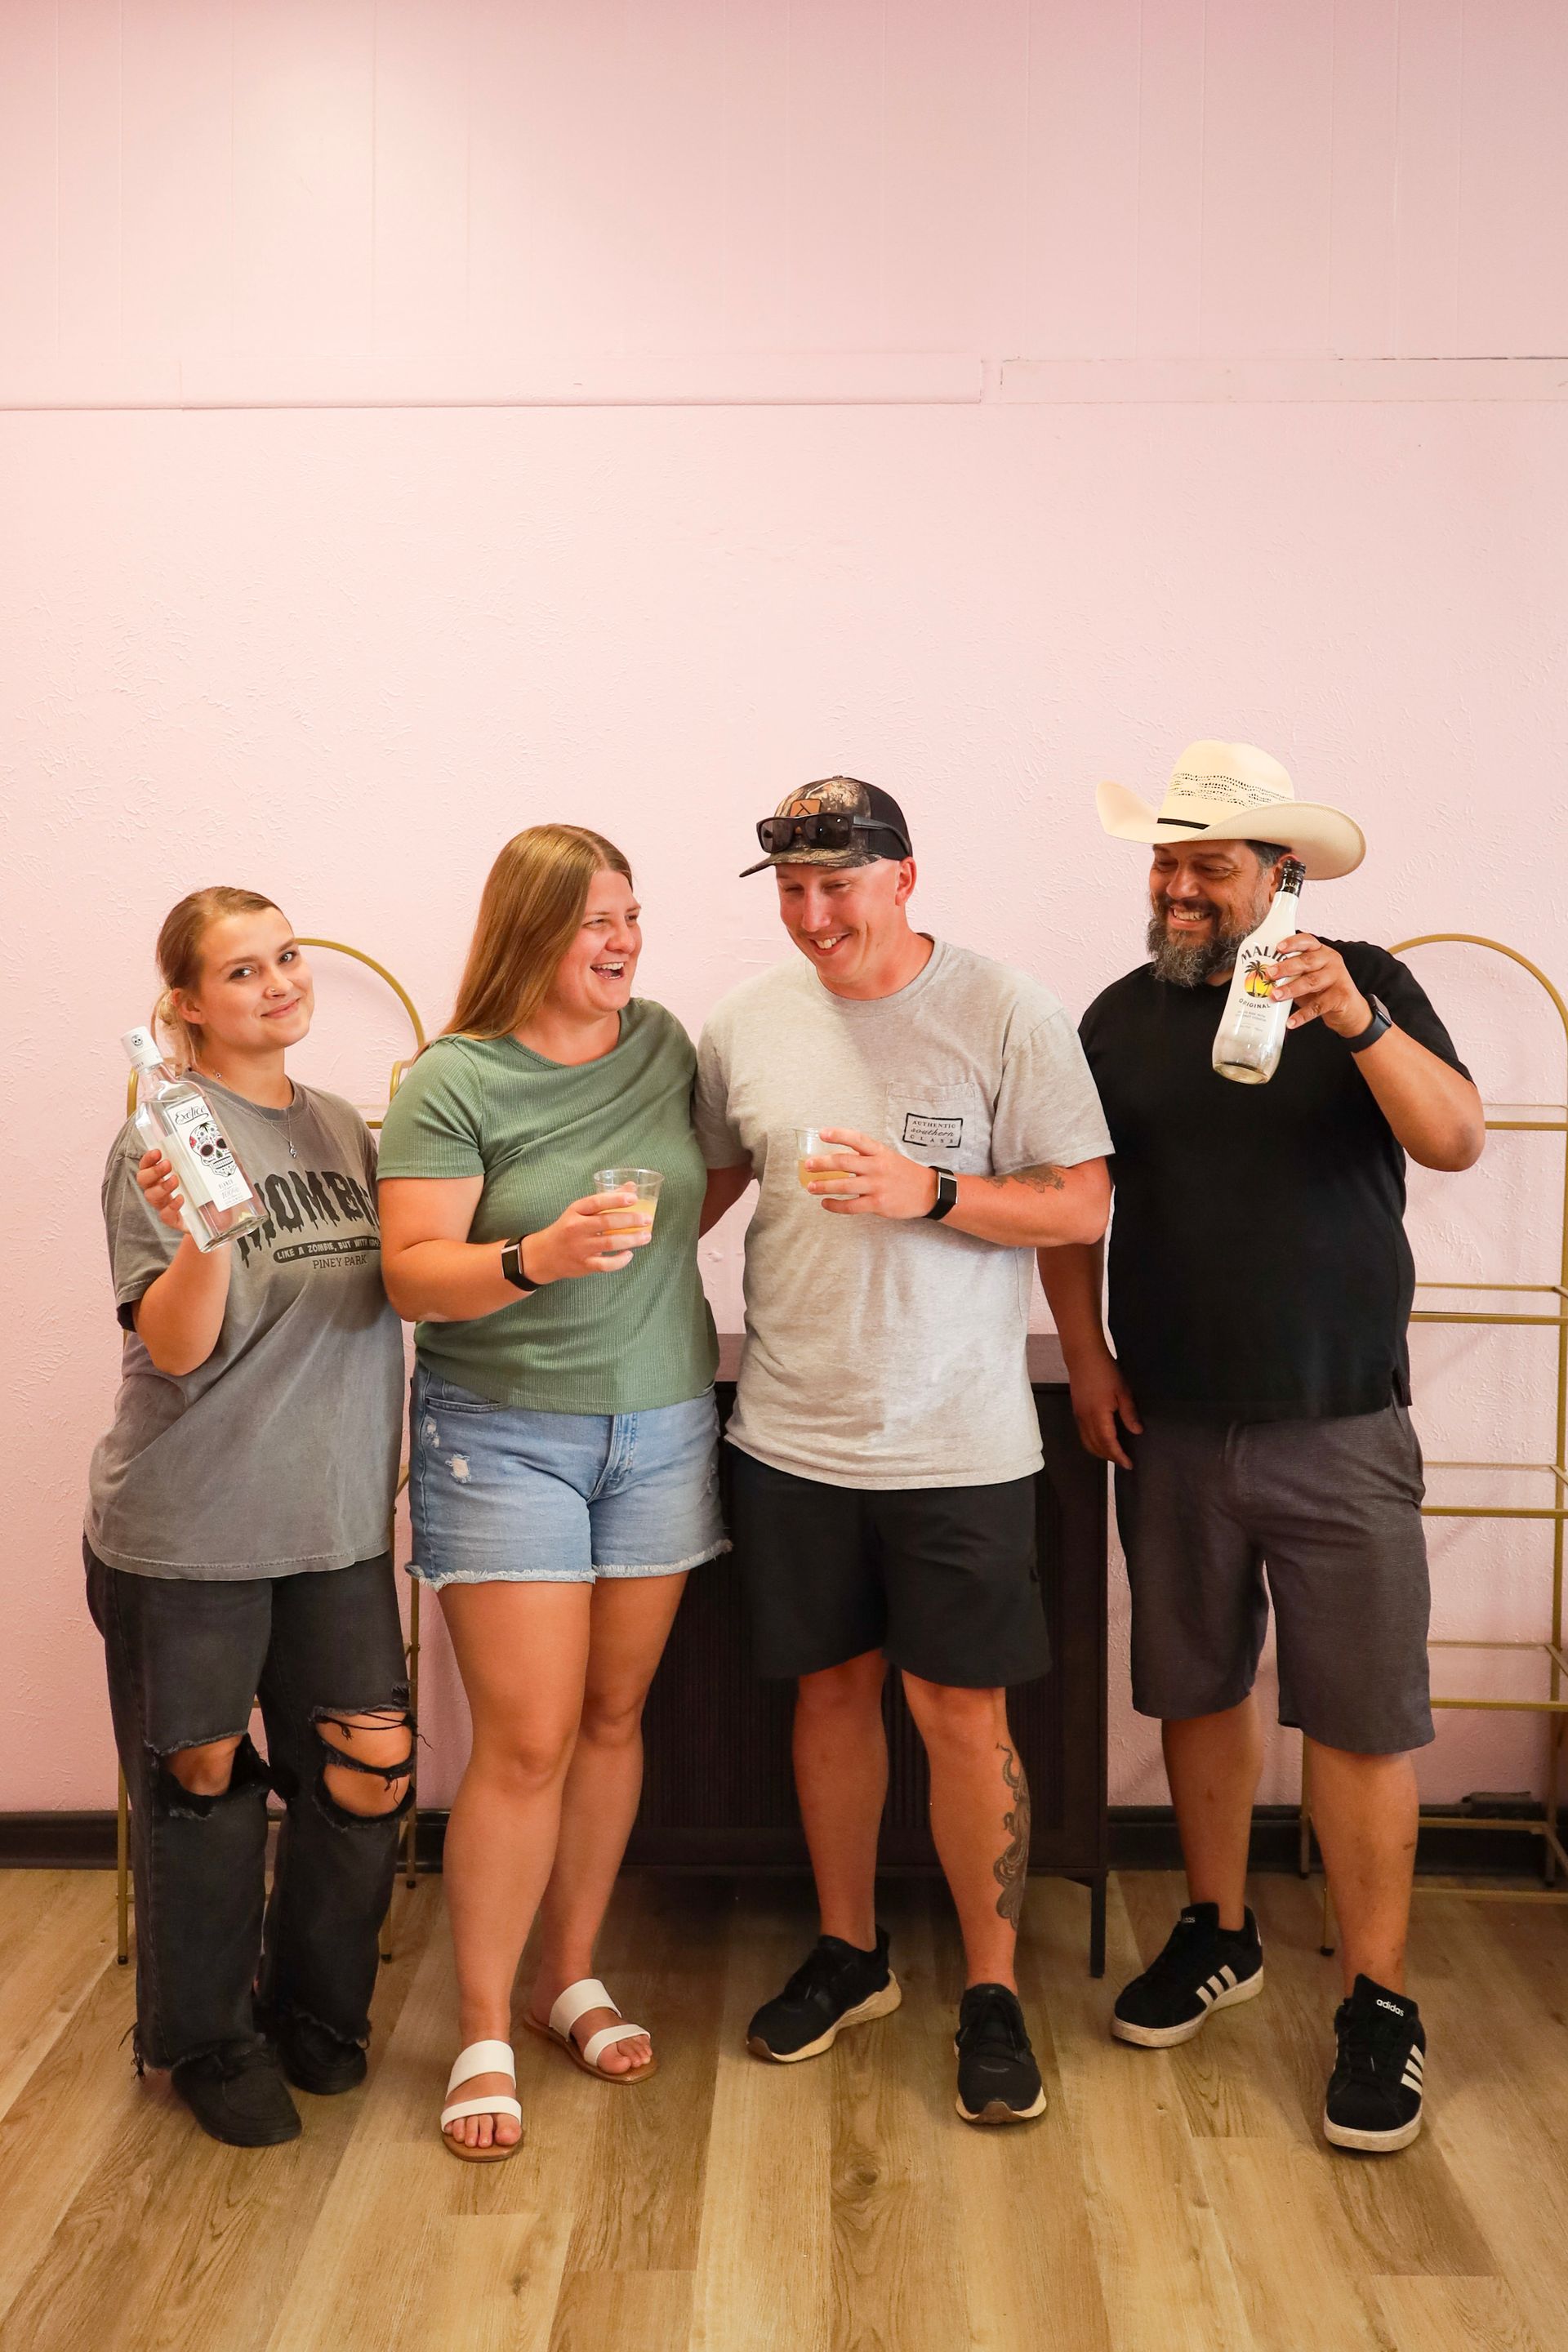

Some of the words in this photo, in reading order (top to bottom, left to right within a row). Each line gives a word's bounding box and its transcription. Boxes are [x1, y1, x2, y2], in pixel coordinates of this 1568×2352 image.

[1238, 998, 1271, 1009] ORIGINAL
[912, 1120, 956, 1129] AUTHENTIC
[910, 1128, 954, 1138] southern
[910, 1134, 953, 1144] CLASS
[276, 1249, 295, 1260] LIKE
[298, 1246, 305, 1256] A
[307, 1242, 337, 1254] ZOMBIE,
[337, 1241, 351, 1250] BUT
[313, 1258, 344, 1269] PINEY
[345, 1254, 368, 1267] PARK
[1375, 1998, 1405, 2017] adidas
